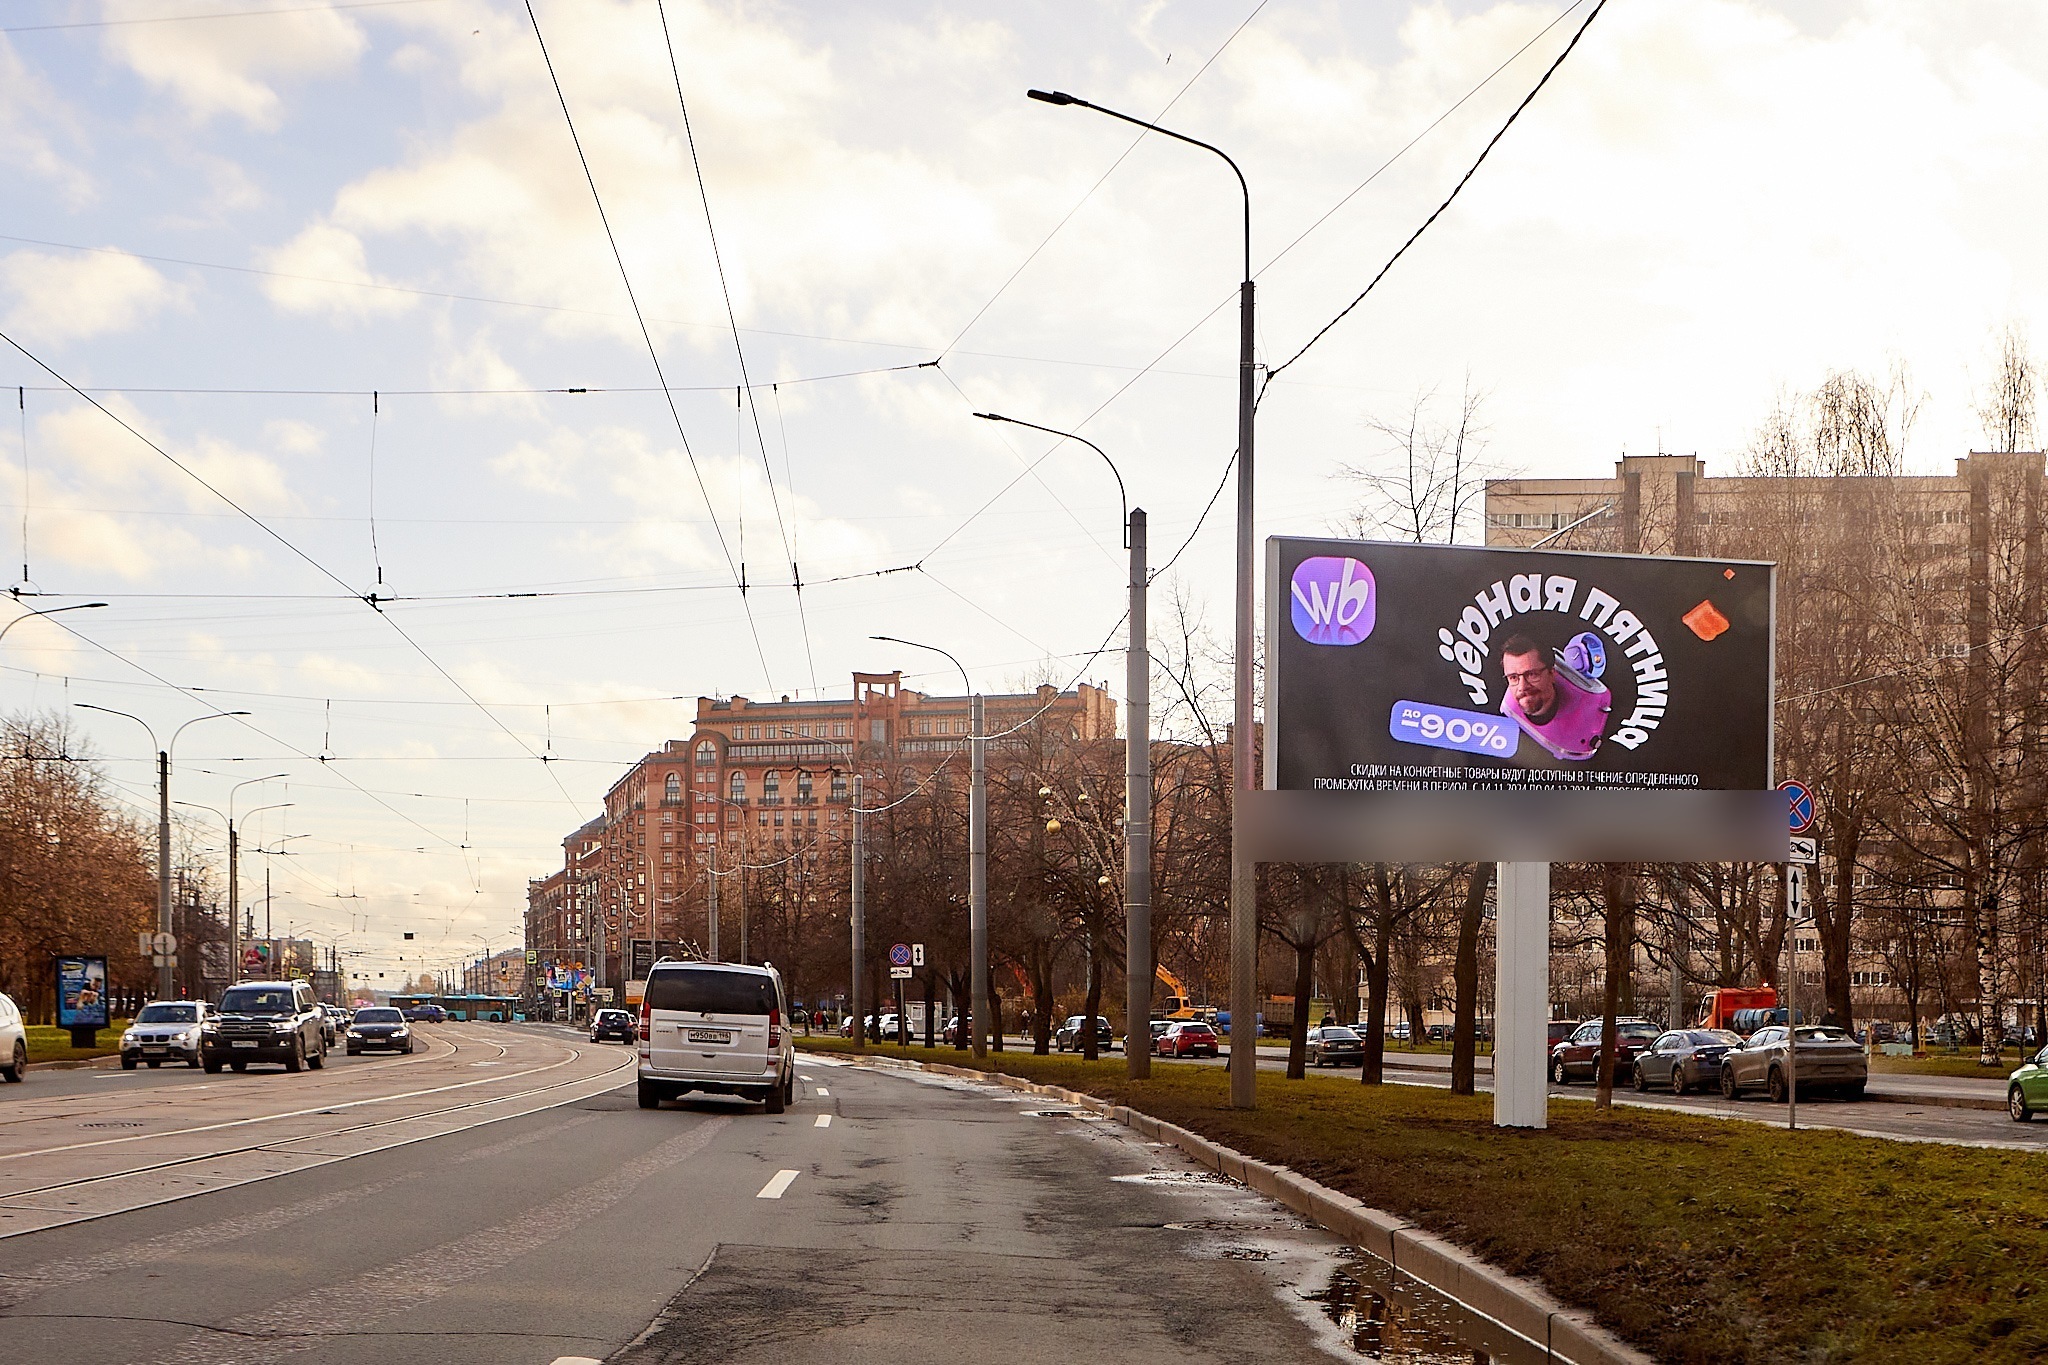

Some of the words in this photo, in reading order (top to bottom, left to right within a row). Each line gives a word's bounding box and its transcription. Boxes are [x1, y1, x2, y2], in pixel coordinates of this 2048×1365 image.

[1402, 709, 1421, 719] до
[1350, 763, 1387, 779] СКИДКИ
[1389, 765, 1402, 777] НА
[1403, 765, 1462, 779] КОНКРЕТНЫЕ
[1463, 767, 1500, 780] ТОВАРЫ
[1501, 768, 1527, 782] БУДУТ
[1527, 769, 1576, 782] ДОСТУПНЫ
[1577, 770, 1584, 782] В
[1585, 770, 1624, 783] ТЕЧЕНИЕ
[1624, 772, 1699, 786] ОПРЕДЕЛЕННОГО
[1313, 777, 1375, 790] ПРОМЕЖУТКА
[1376, 779, 1421, 790] ВРЕМЕНИ
